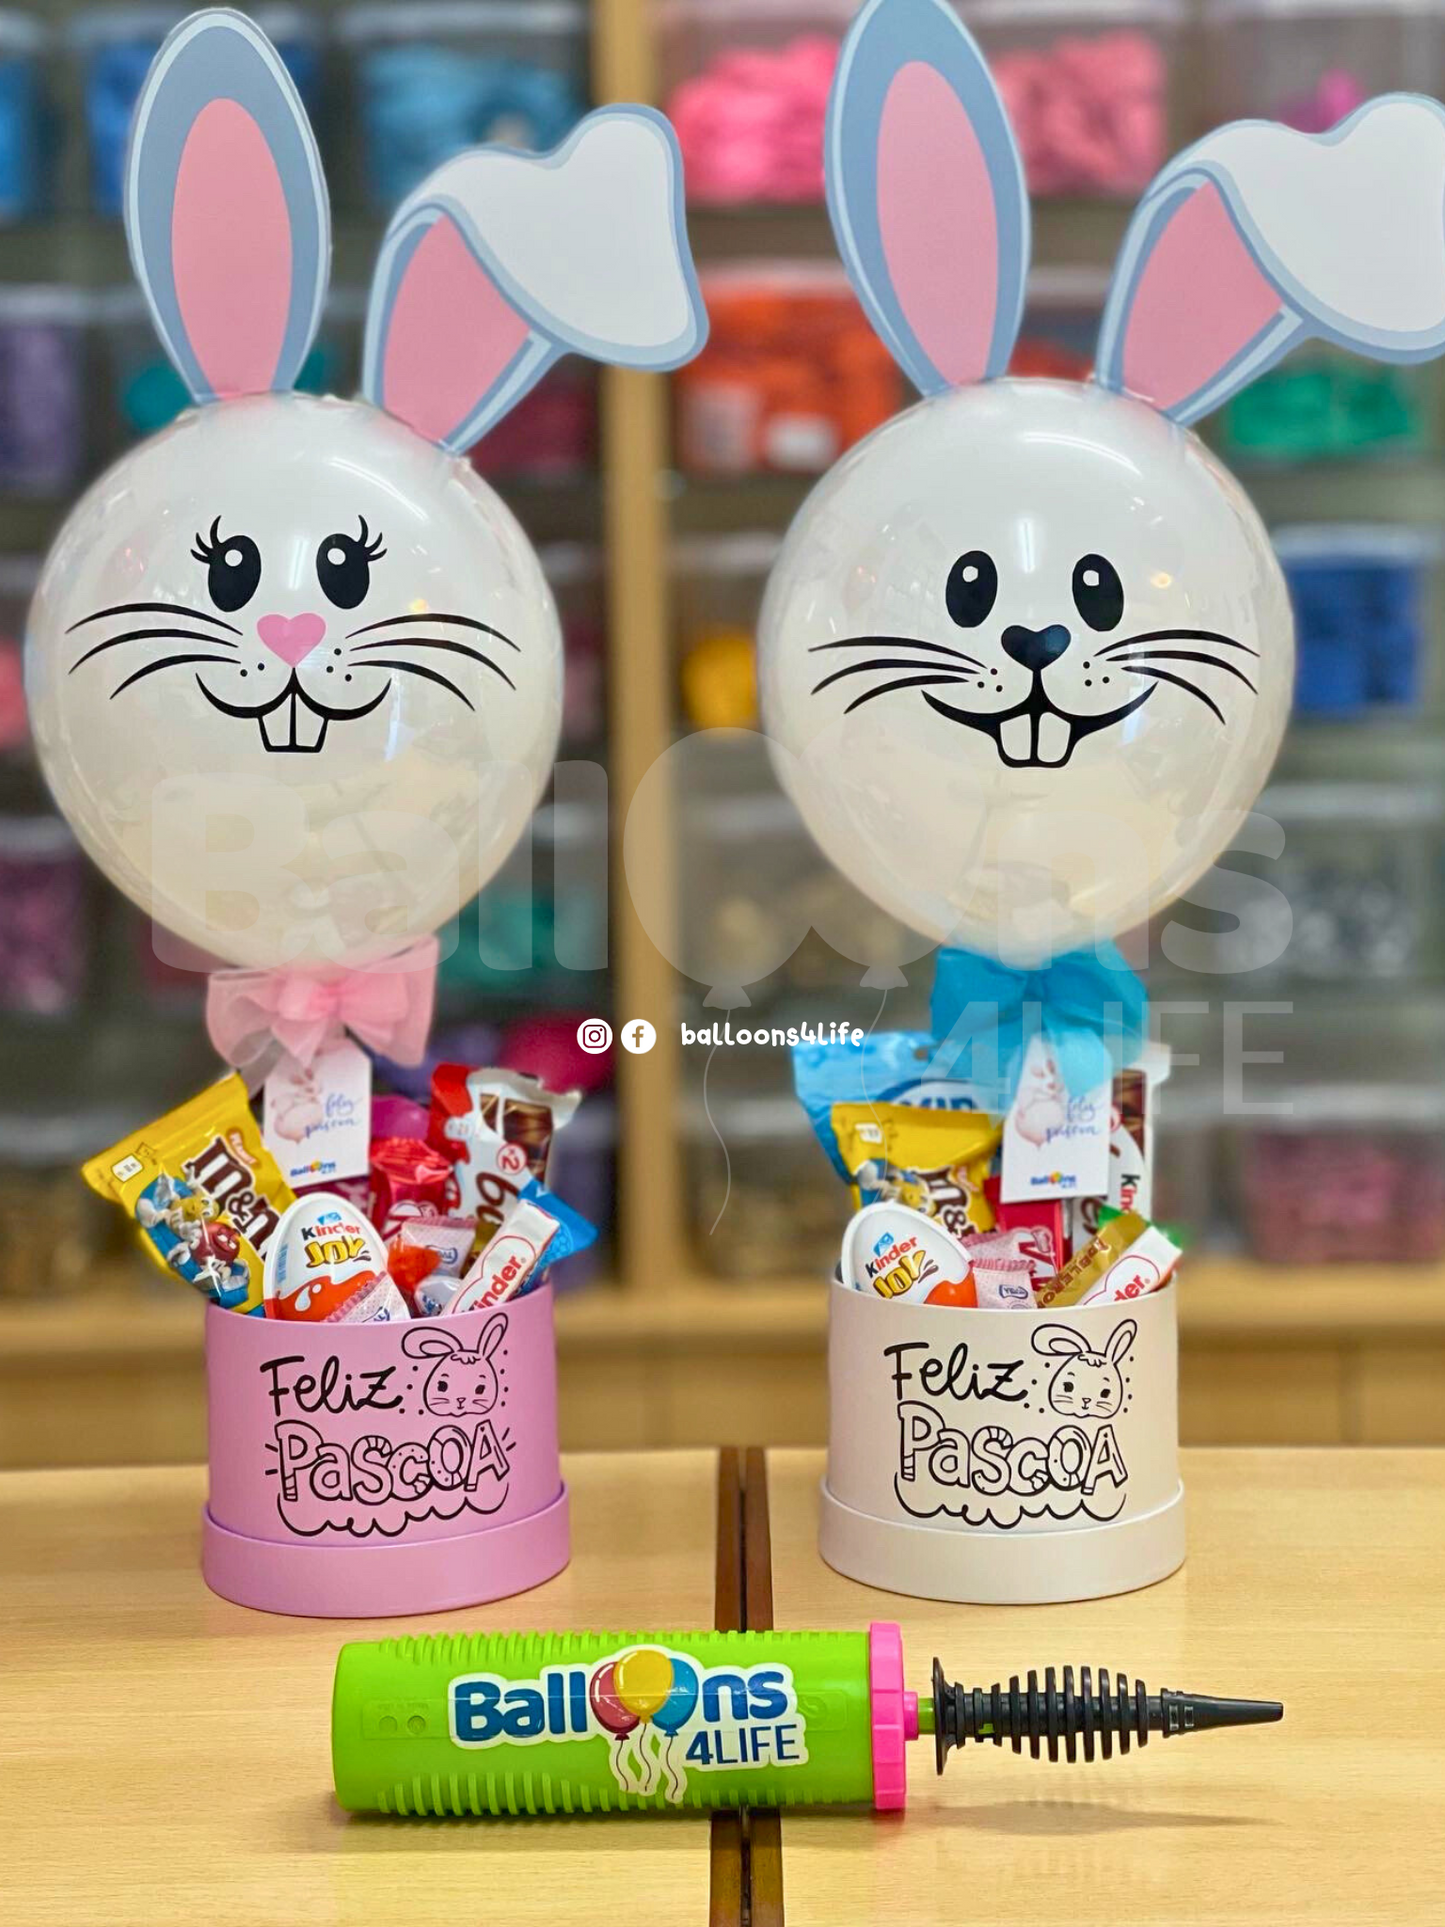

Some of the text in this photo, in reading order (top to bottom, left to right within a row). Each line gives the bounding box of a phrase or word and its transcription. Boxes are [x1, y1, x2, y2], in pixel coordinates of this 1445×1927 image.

[301, 1222, 361, 1241] Kinder
[304, 1235, 365, 1269] JOY
[865, 1236, 918, 1279] Kinder
[260, 1355, 403, 1416] Feliz
[884, 1341, 1028, 1401] Feliz
[685, 1724, 800, 1766] 4LIFE
